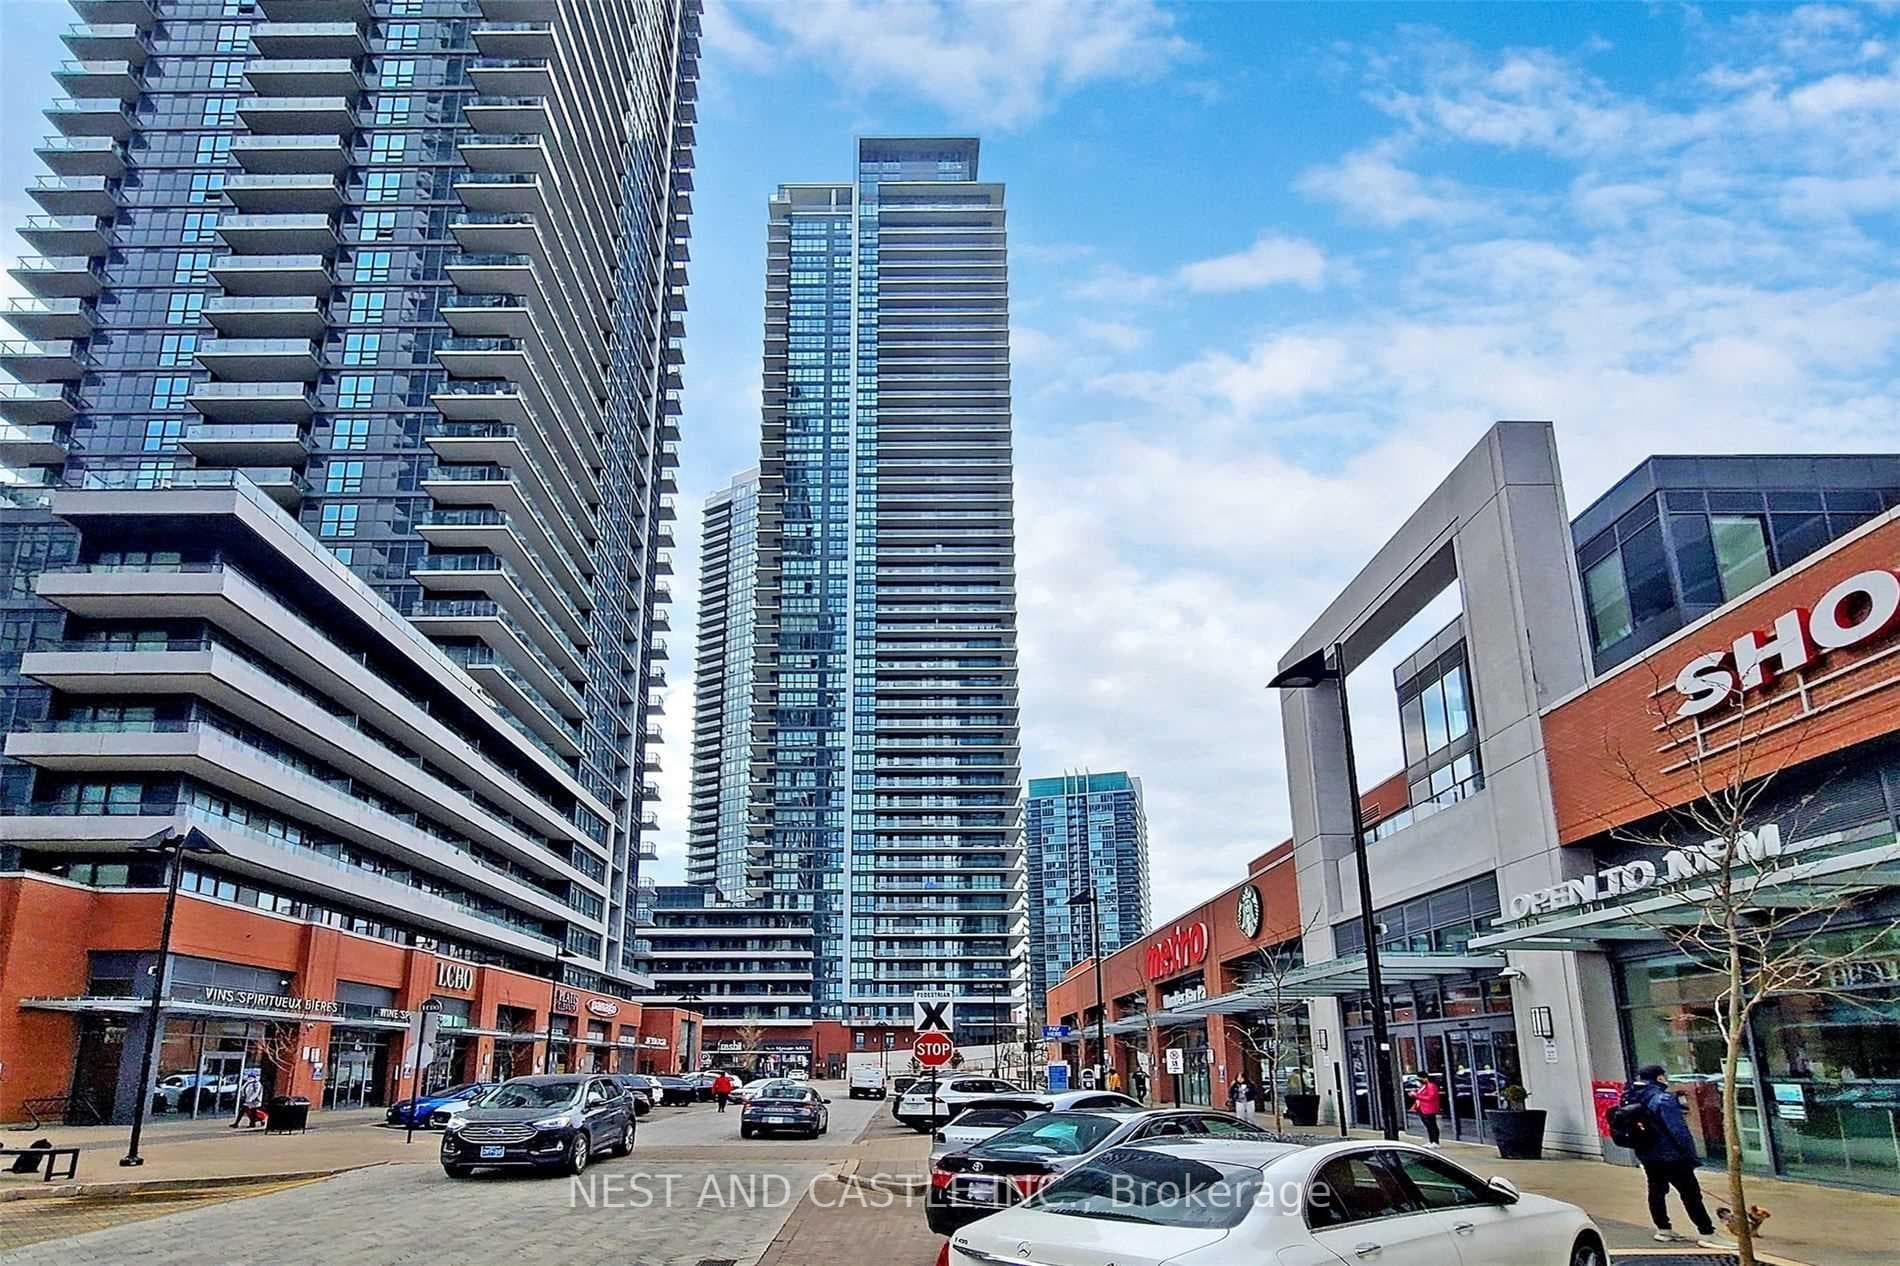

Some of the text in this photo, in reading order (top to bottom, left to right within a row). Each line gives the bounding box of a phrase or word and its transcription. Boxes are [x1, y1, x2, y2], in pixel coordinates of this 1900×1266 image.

[1675, 569, 1900, 715] SHO
[1510, 874, 1596, 918] OPEN
[1599, 860, 1656, 896] TO
[1146, 922, 1209, 980] metro
[206, 986, 235, 1003] VINS
[238, 990, 302, 1010] SPIRITUEUX
[437, 962, 473, 992] LCBO
[916, 1043, 951, 1056] STOP
